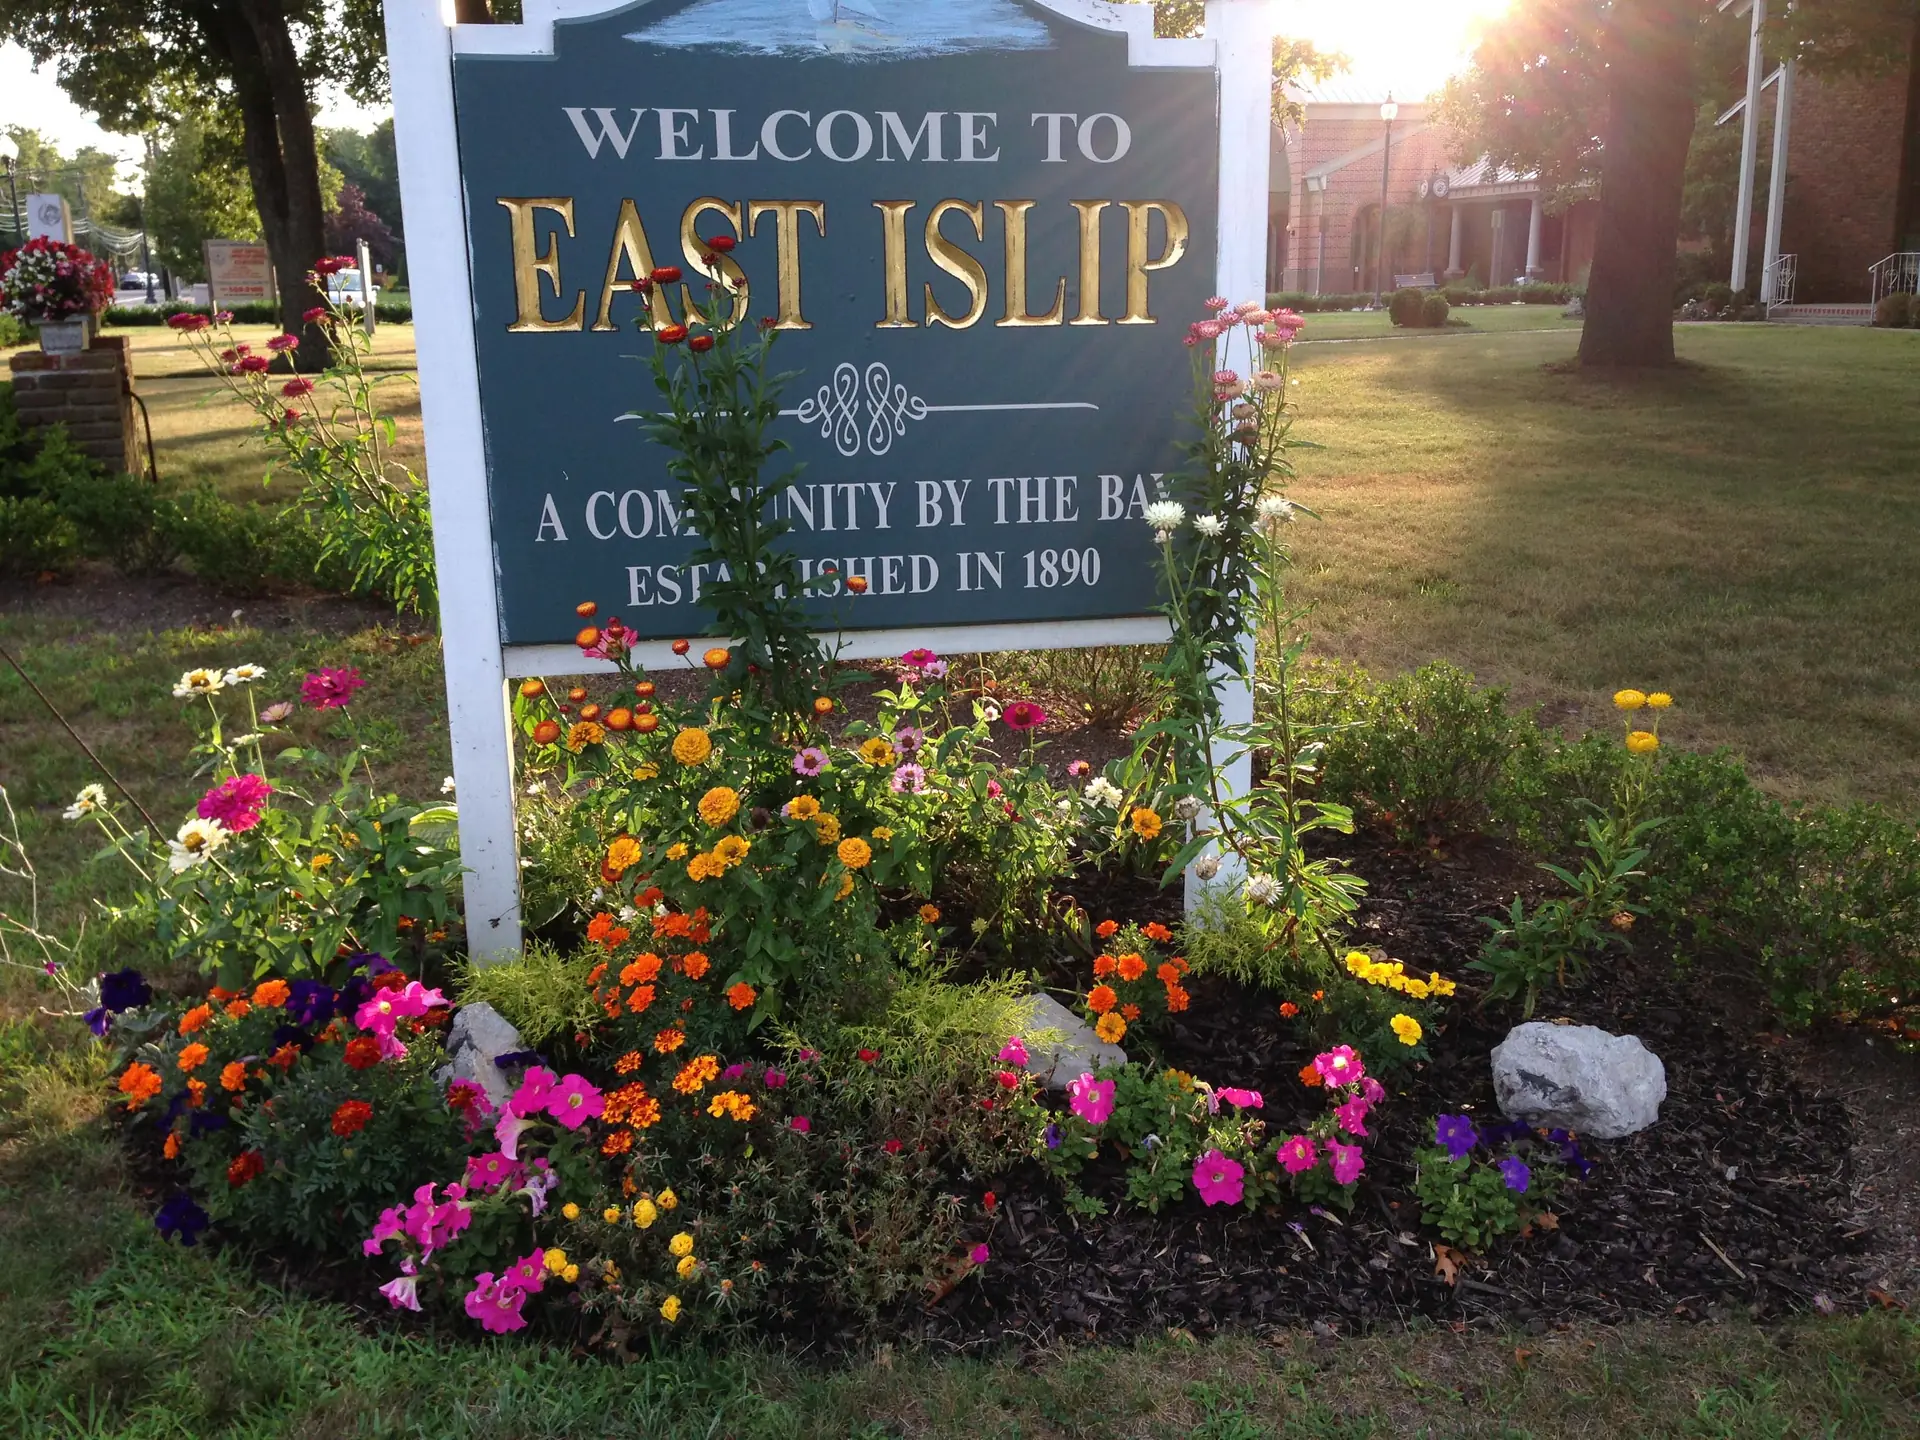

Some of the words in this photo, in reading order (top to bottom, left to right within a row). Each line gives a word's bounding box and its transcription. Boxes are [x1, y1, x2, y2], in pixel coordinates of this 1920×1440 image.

[562, 106, 1001, 164] WELCOME
[1030, 111, 1133, 164] TO
[497, 195, 826, 334] EAST
[873, 197, 1190, 331] ISLIP
[534, 492, 569, 542] A
[585, 481, 897, 541] COMNITY
[915, 478, 972, 528] BY
[987, 475, 1080, 525] THE
[956, 550, 1005, 592] IN
[1022, 547, 1101, 588] 1890
